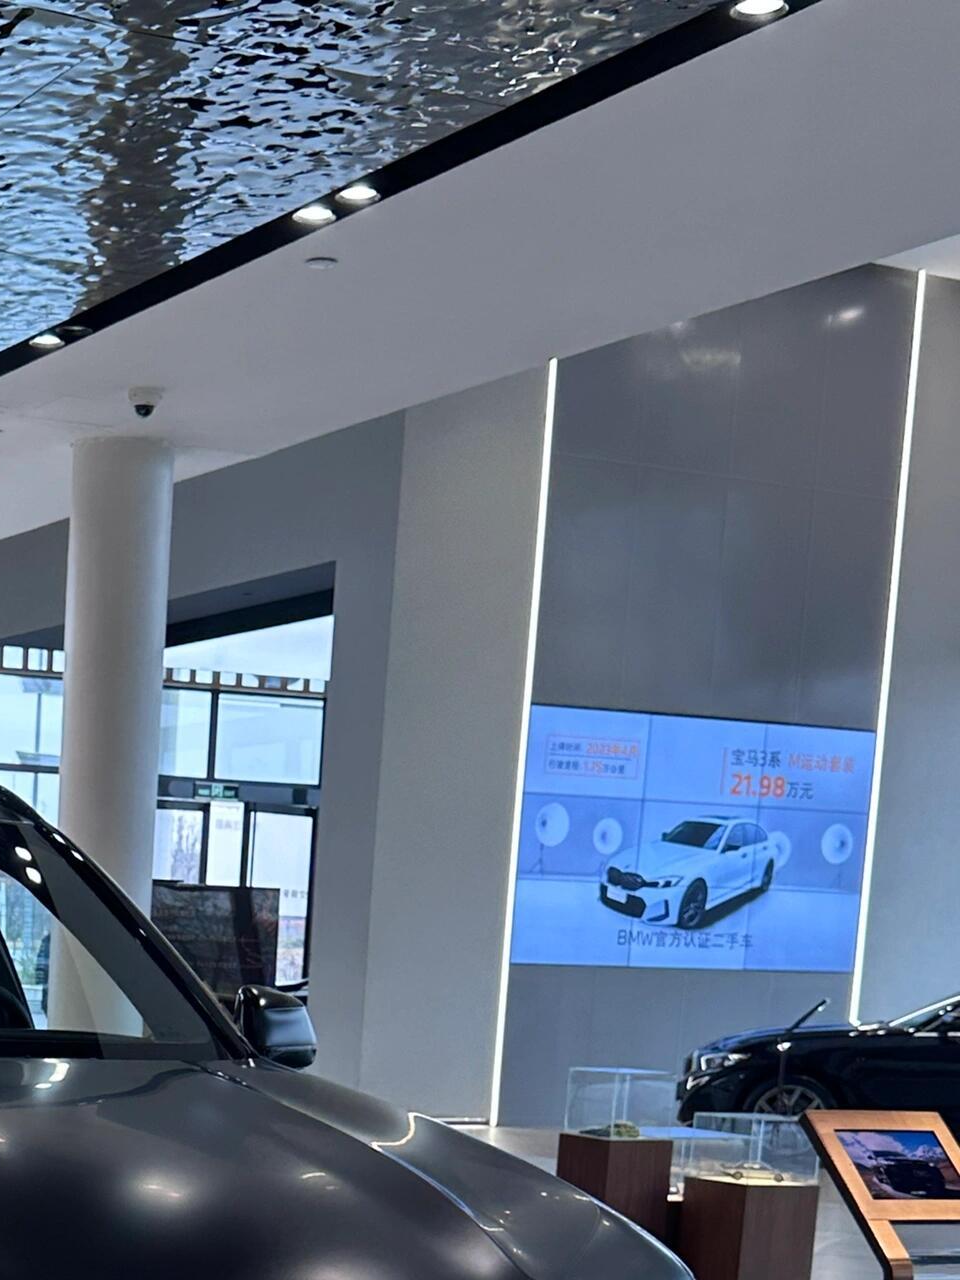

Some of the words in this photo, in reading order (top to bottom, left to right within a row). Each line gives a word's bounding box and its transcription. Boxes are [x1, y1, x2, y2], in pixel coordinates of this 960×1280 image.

[731, 748, 782, 768] 宝马3系
[730, 771, 814, 799] 21.98万元
[616, 929, 753, 950] BMW官方认证二手车
